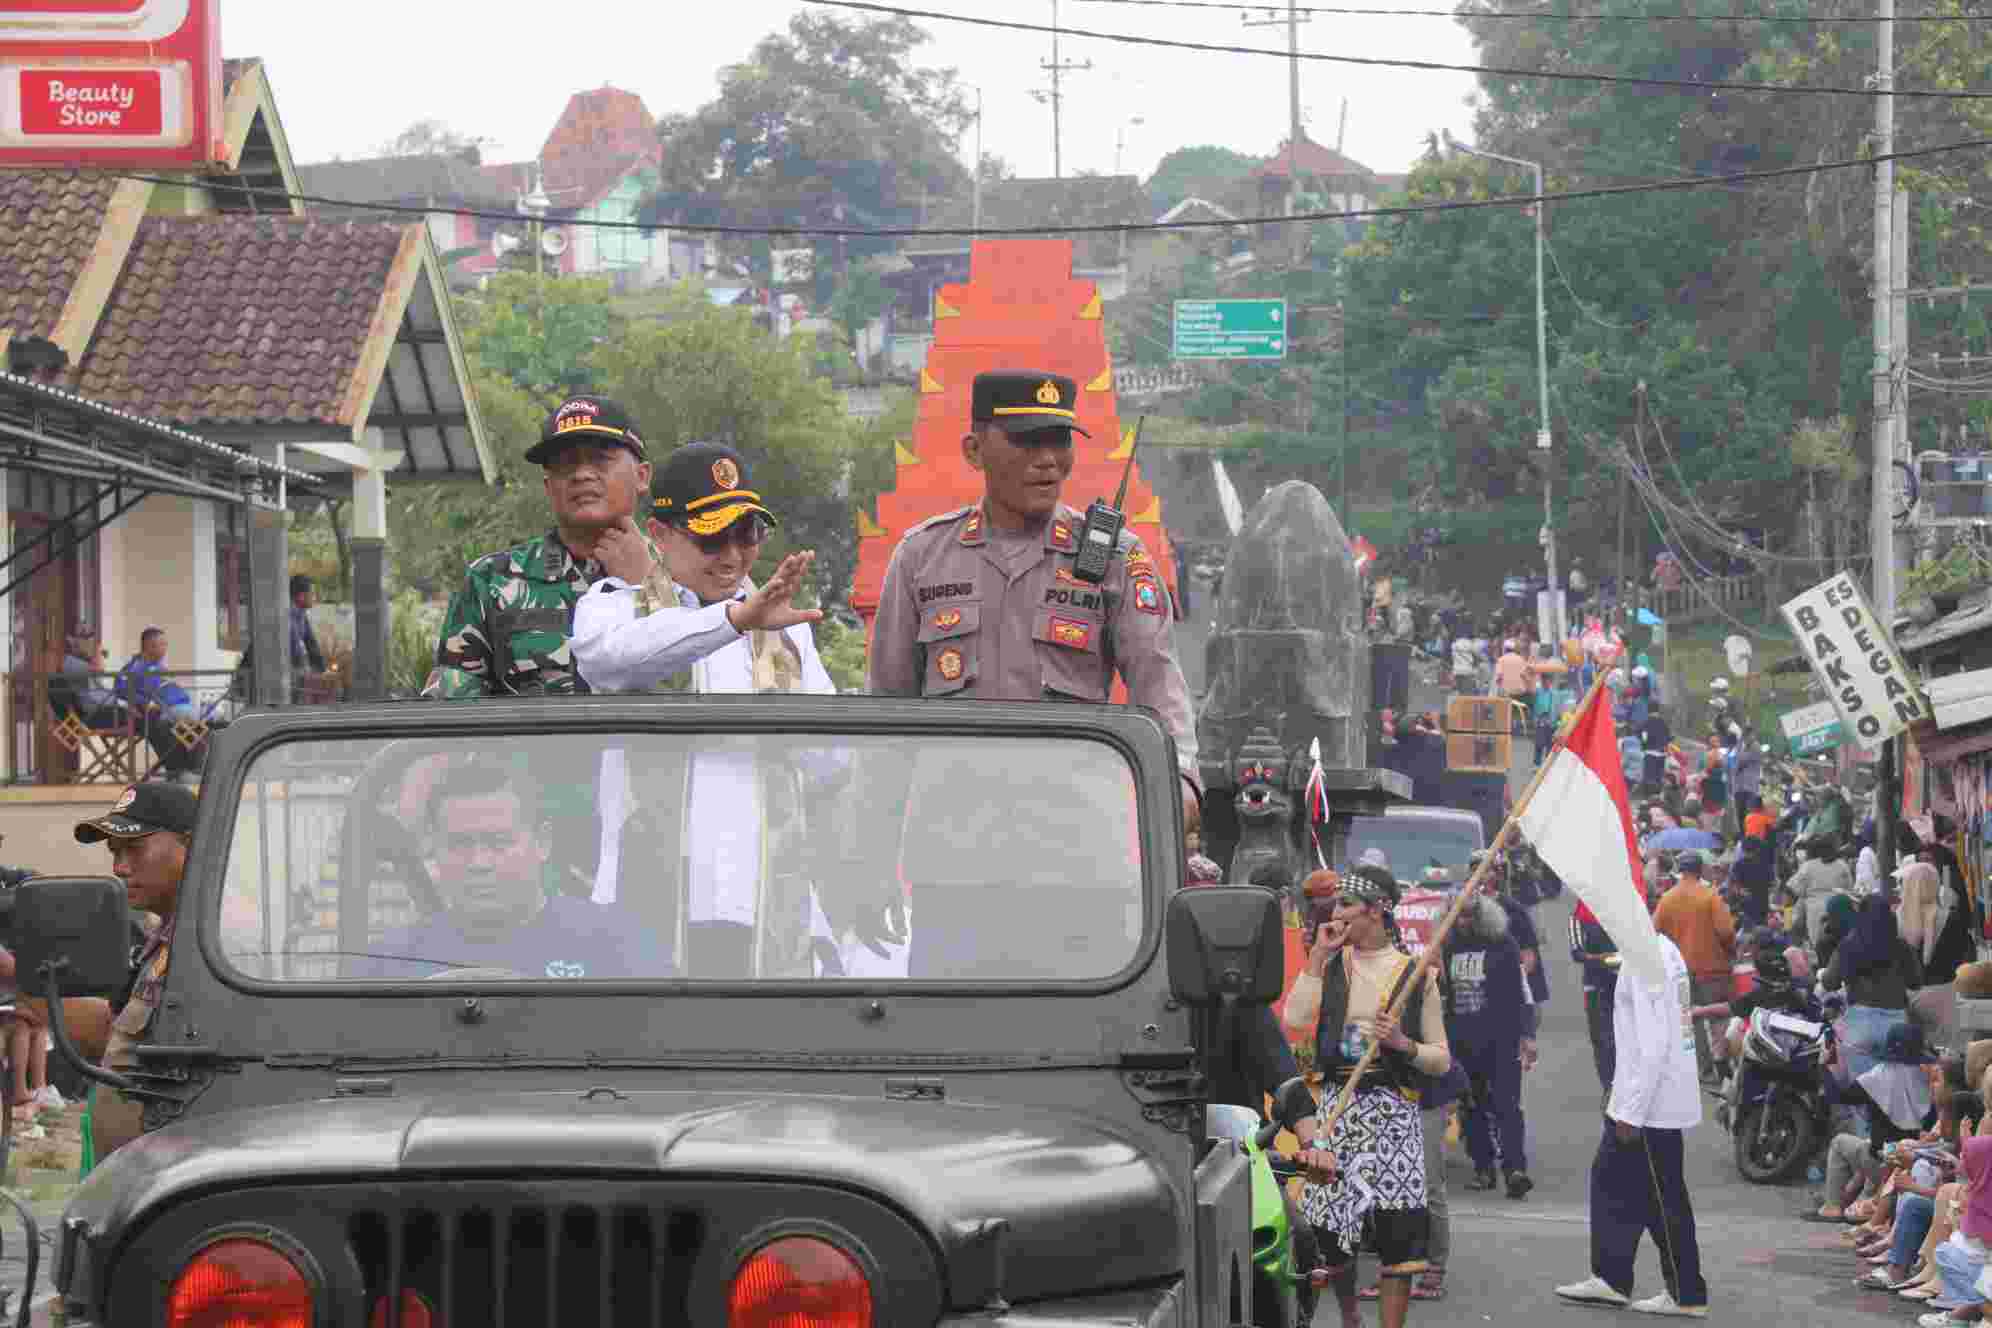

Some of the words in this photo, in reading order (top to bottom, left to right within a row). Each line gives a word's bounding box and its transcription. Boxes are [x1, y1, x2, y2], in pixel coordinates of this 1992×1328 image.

[48, 80, 134, 108] Beauty
[59, 104, 120, 126] Store
[1045, 590, 1101, 609] POLRI
[1824, 580, 1853, 607] ES
[1840, 606, 1920, 722] DEGAN
[1795, 605, 1880, 737] BAKSO
